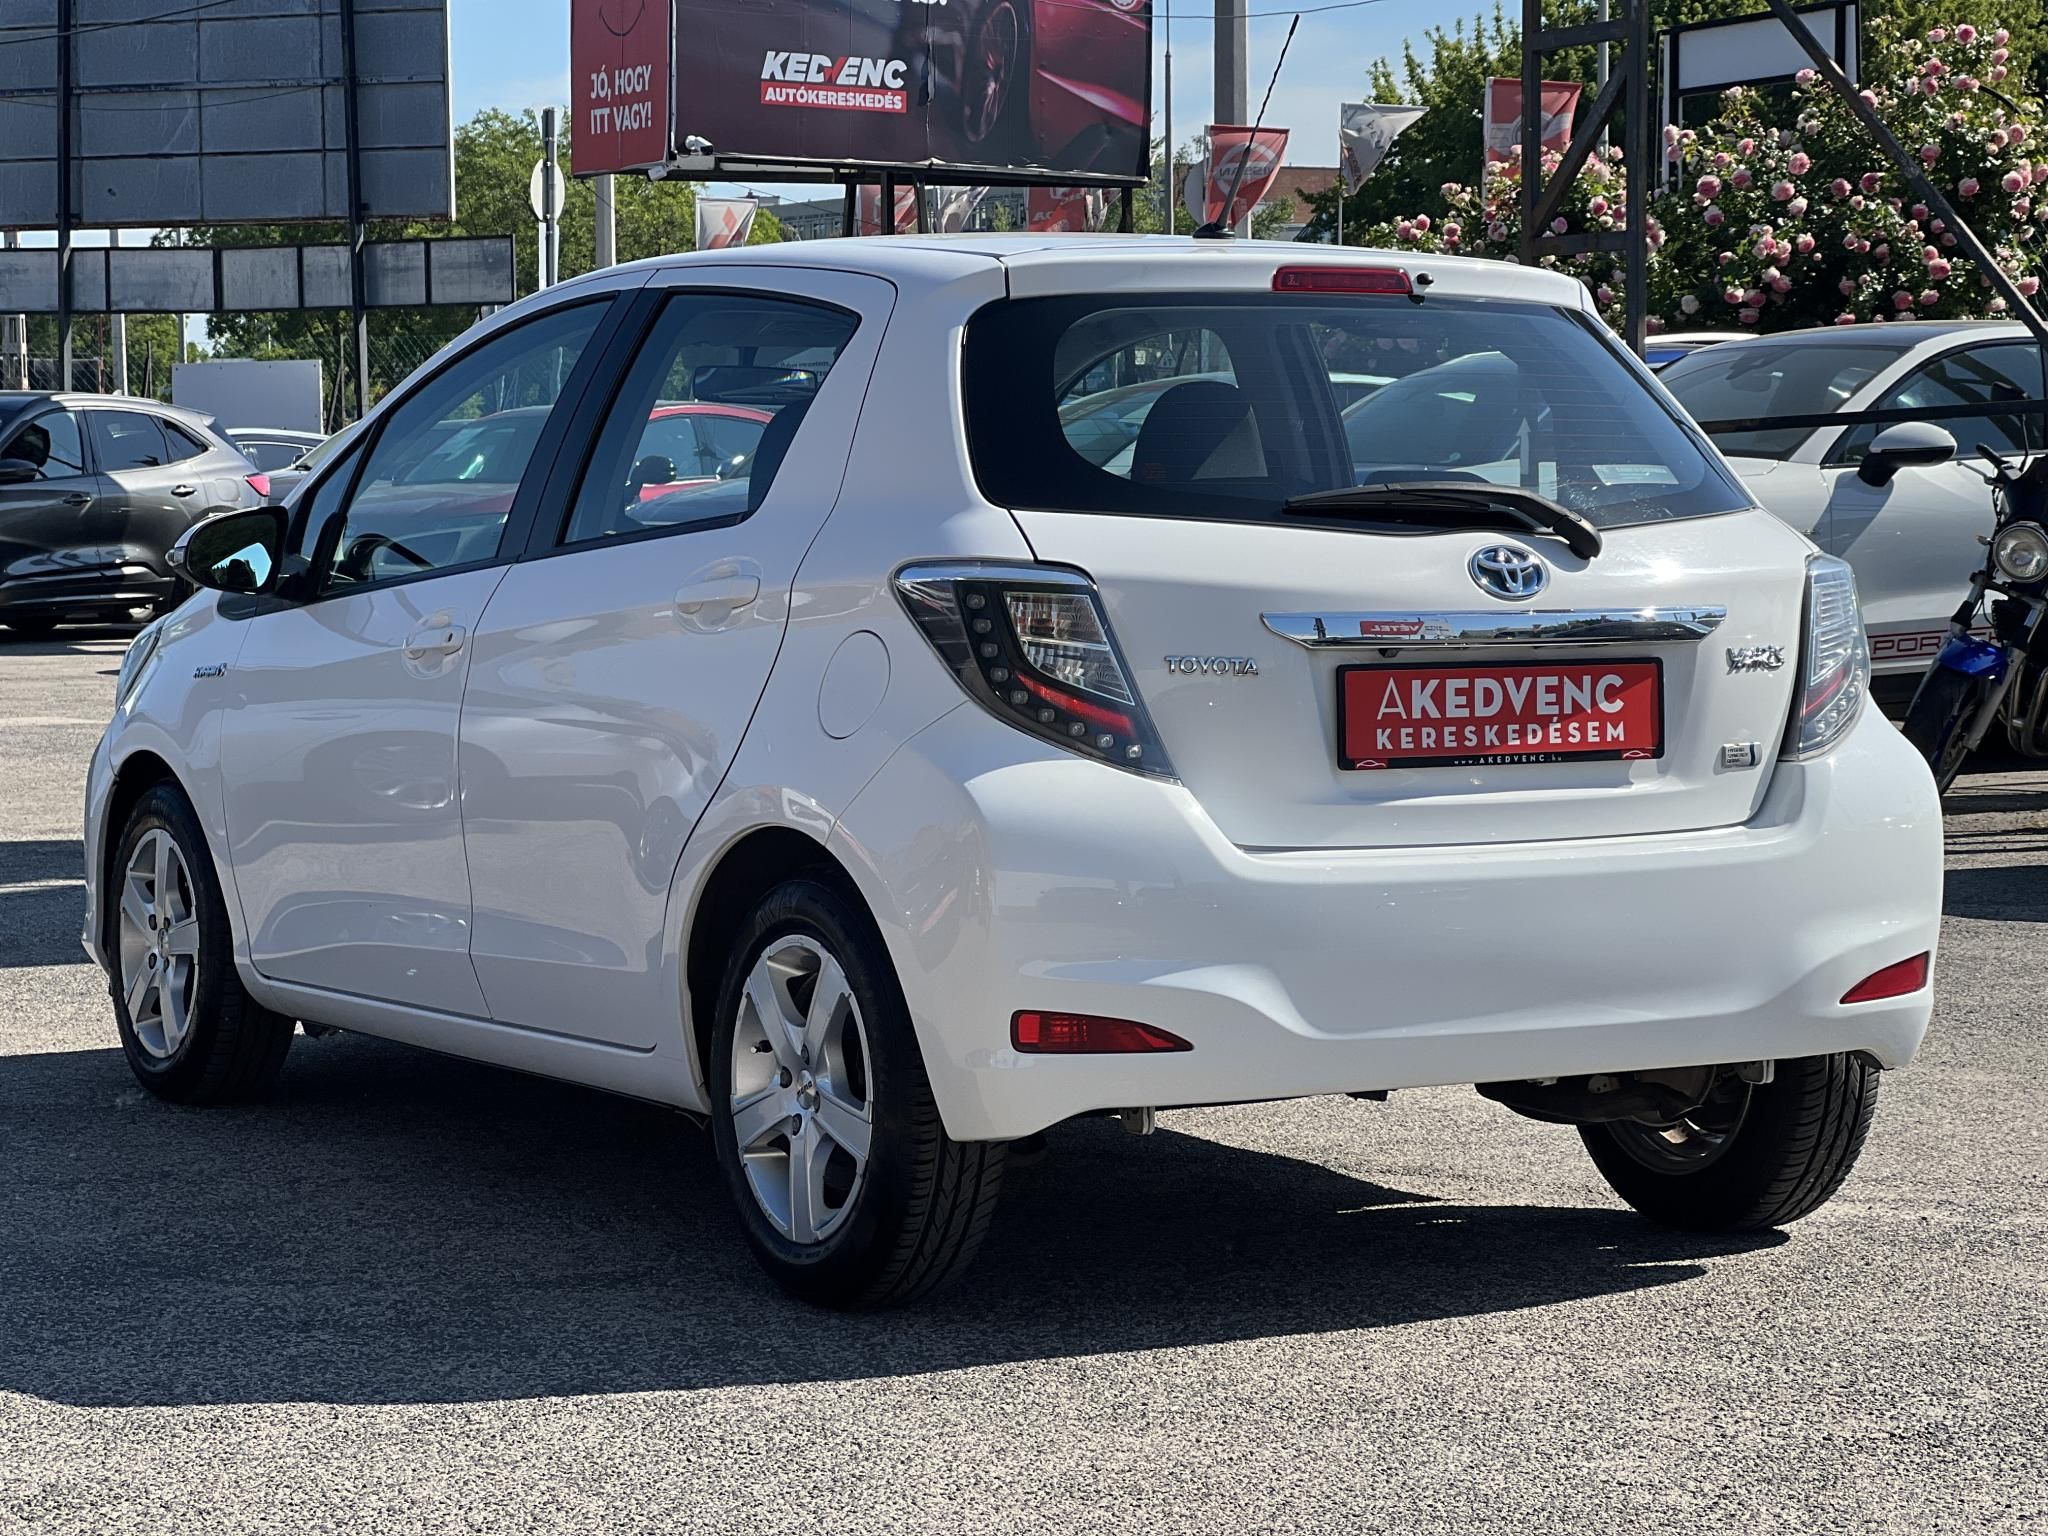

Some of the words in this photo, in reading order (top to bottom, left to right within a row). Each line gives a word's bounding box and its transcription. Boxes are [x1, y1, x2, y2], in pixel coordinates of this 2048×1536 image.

[590, 64, 611, 102] JÓ,
[615, 64, 652, 95] HOGY
[761, 50, 908, 89] KEDVENC
[765, 86, 902, 110] AUTÓKERESKEDÉS
[591, 107, 610, 135] ITT
[613, 101, 652, 132] VAGY!
[1164, 655, 1259, 676] TOYOTA
[1376, 717, 1626, 750] KERESKEDÉSEM
